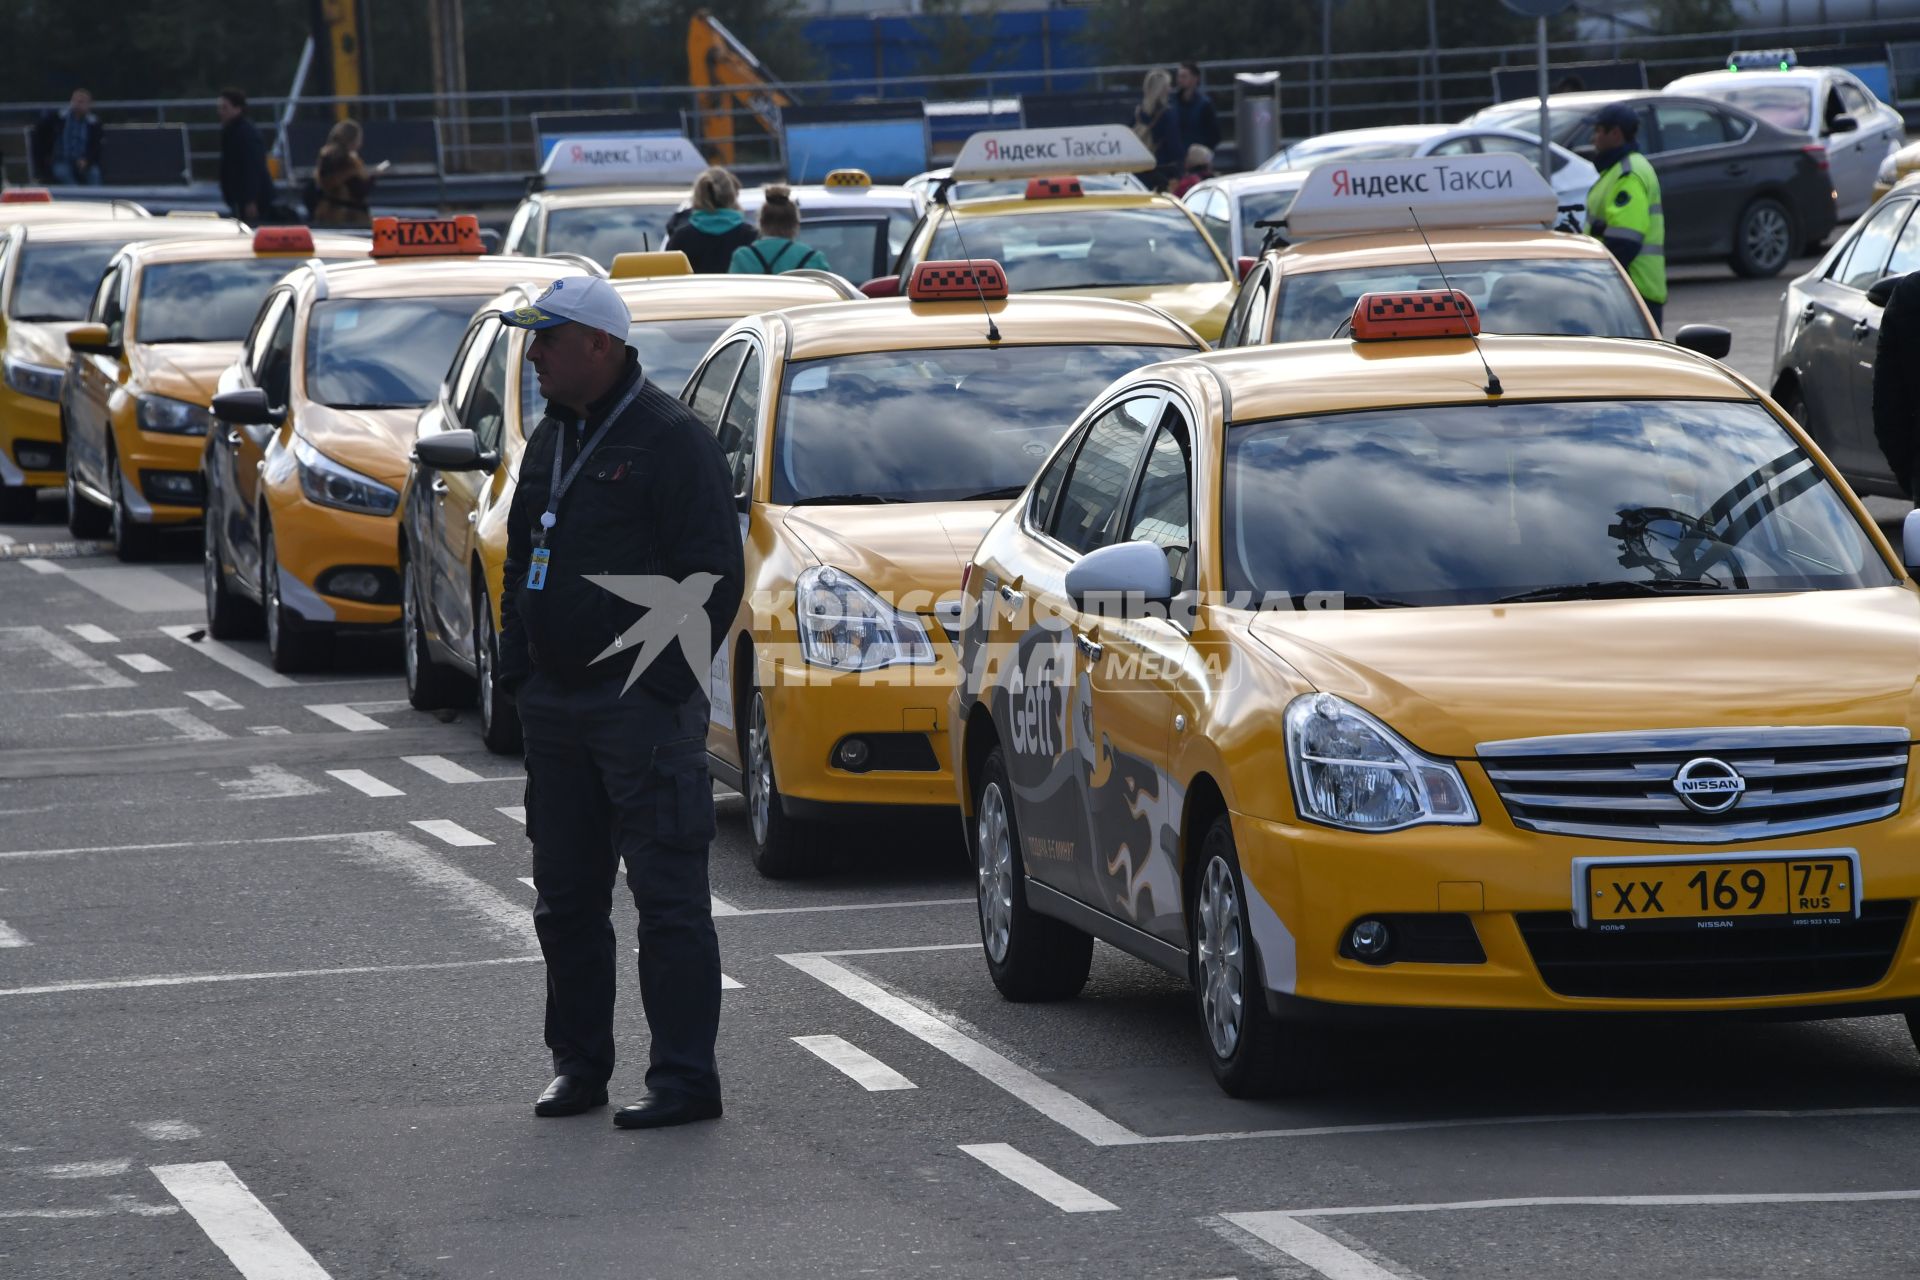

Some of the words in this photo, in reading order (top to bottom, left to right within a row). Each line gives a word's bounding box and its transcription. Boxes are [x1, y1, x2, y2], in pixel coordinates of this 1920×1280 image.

[571, 145, 630, 164] Яндекс
[634, 145, 683, 163] Такси
[985, 139, 1058, 161] Яндекс
[1062, 137, 1121, 157] Такси
[1332, 170, 1429, 197] Яндекс
[1433, 166, 1513, 192] Такси
[399, 223, 455, 243] TAXI
[1009, 665, 1054, 756] Gett
[1682, 780, 1739, 790] NISSAN
[1688, 869, 1765, 911] 169
[1793, 865, 1834, 895] 77
[1800, 897, 1831, 909] RUS
[1697, 921, 1734, 929] NISSAN
